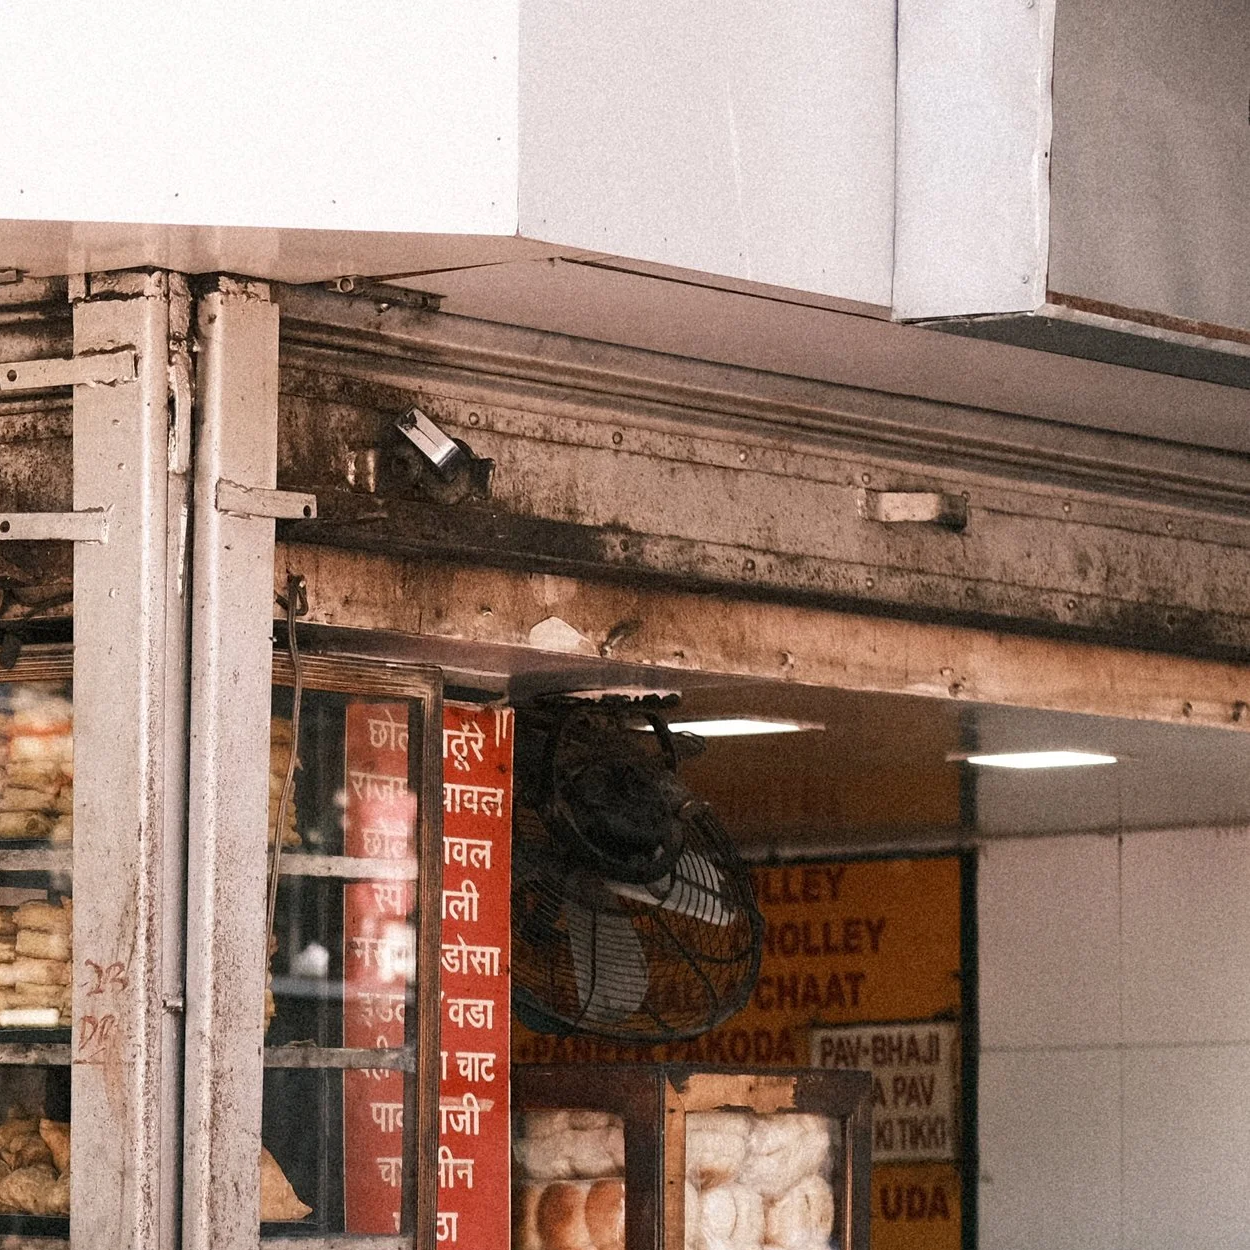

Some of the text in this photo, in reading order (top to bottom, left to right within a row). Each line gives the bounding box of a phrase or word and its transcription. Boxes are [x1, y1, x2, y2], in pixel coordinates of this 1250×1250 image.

[456, 1051, 497, 1083] चाट
[820, 1033, 940, 1068] PAV-BHAJI
[893, 1074, 936, 1108] PAV
